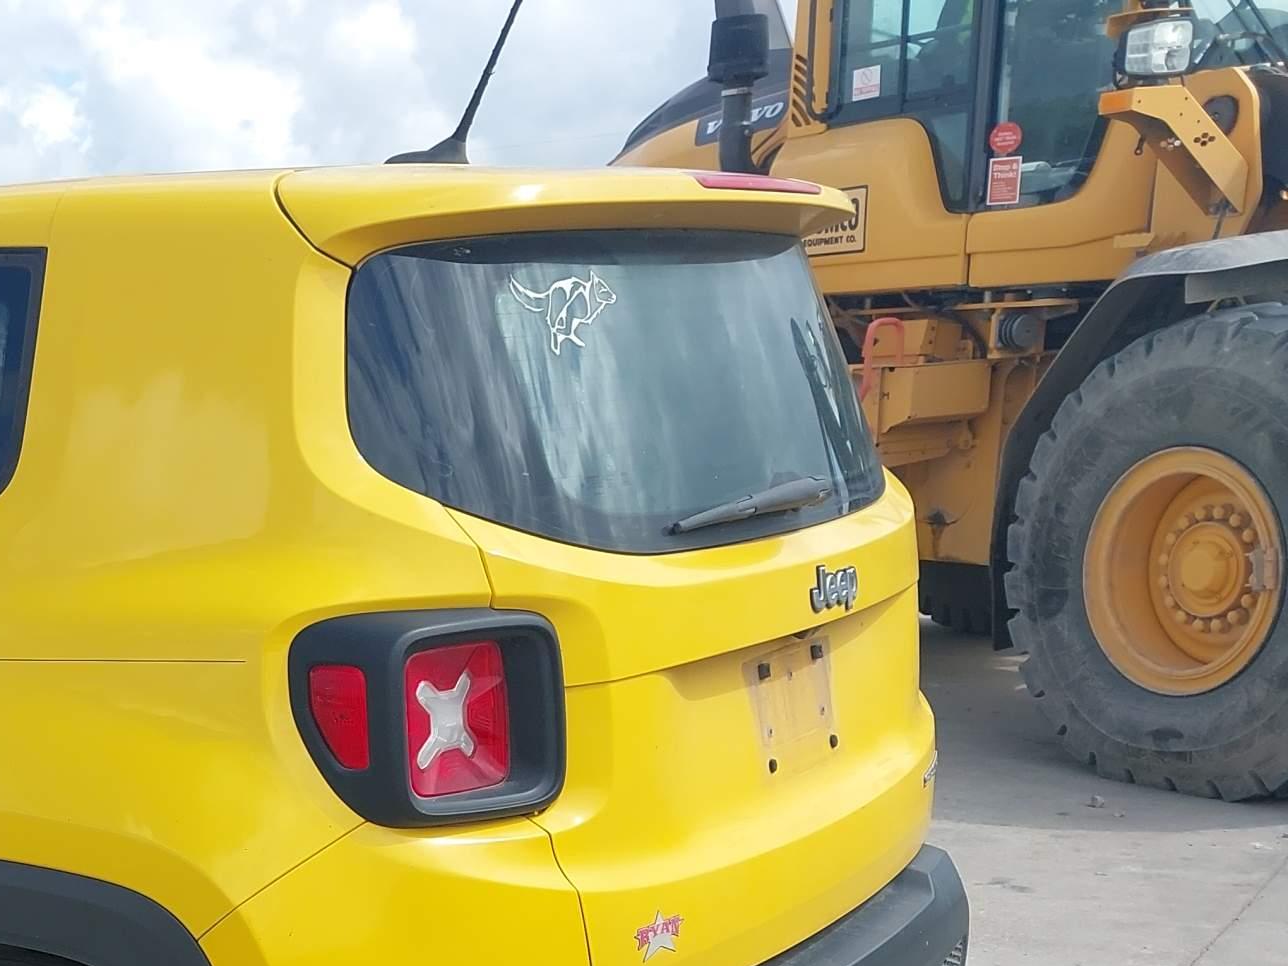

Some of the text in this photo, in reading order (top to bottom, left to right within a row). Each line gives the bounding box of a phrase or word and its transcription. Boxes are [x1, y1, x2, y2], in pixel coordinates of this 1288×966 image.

[707, 102, 784, 134] VVO
[809, 564, 858, 613] Jeep
[635, 915, 682, 949] RYAN
